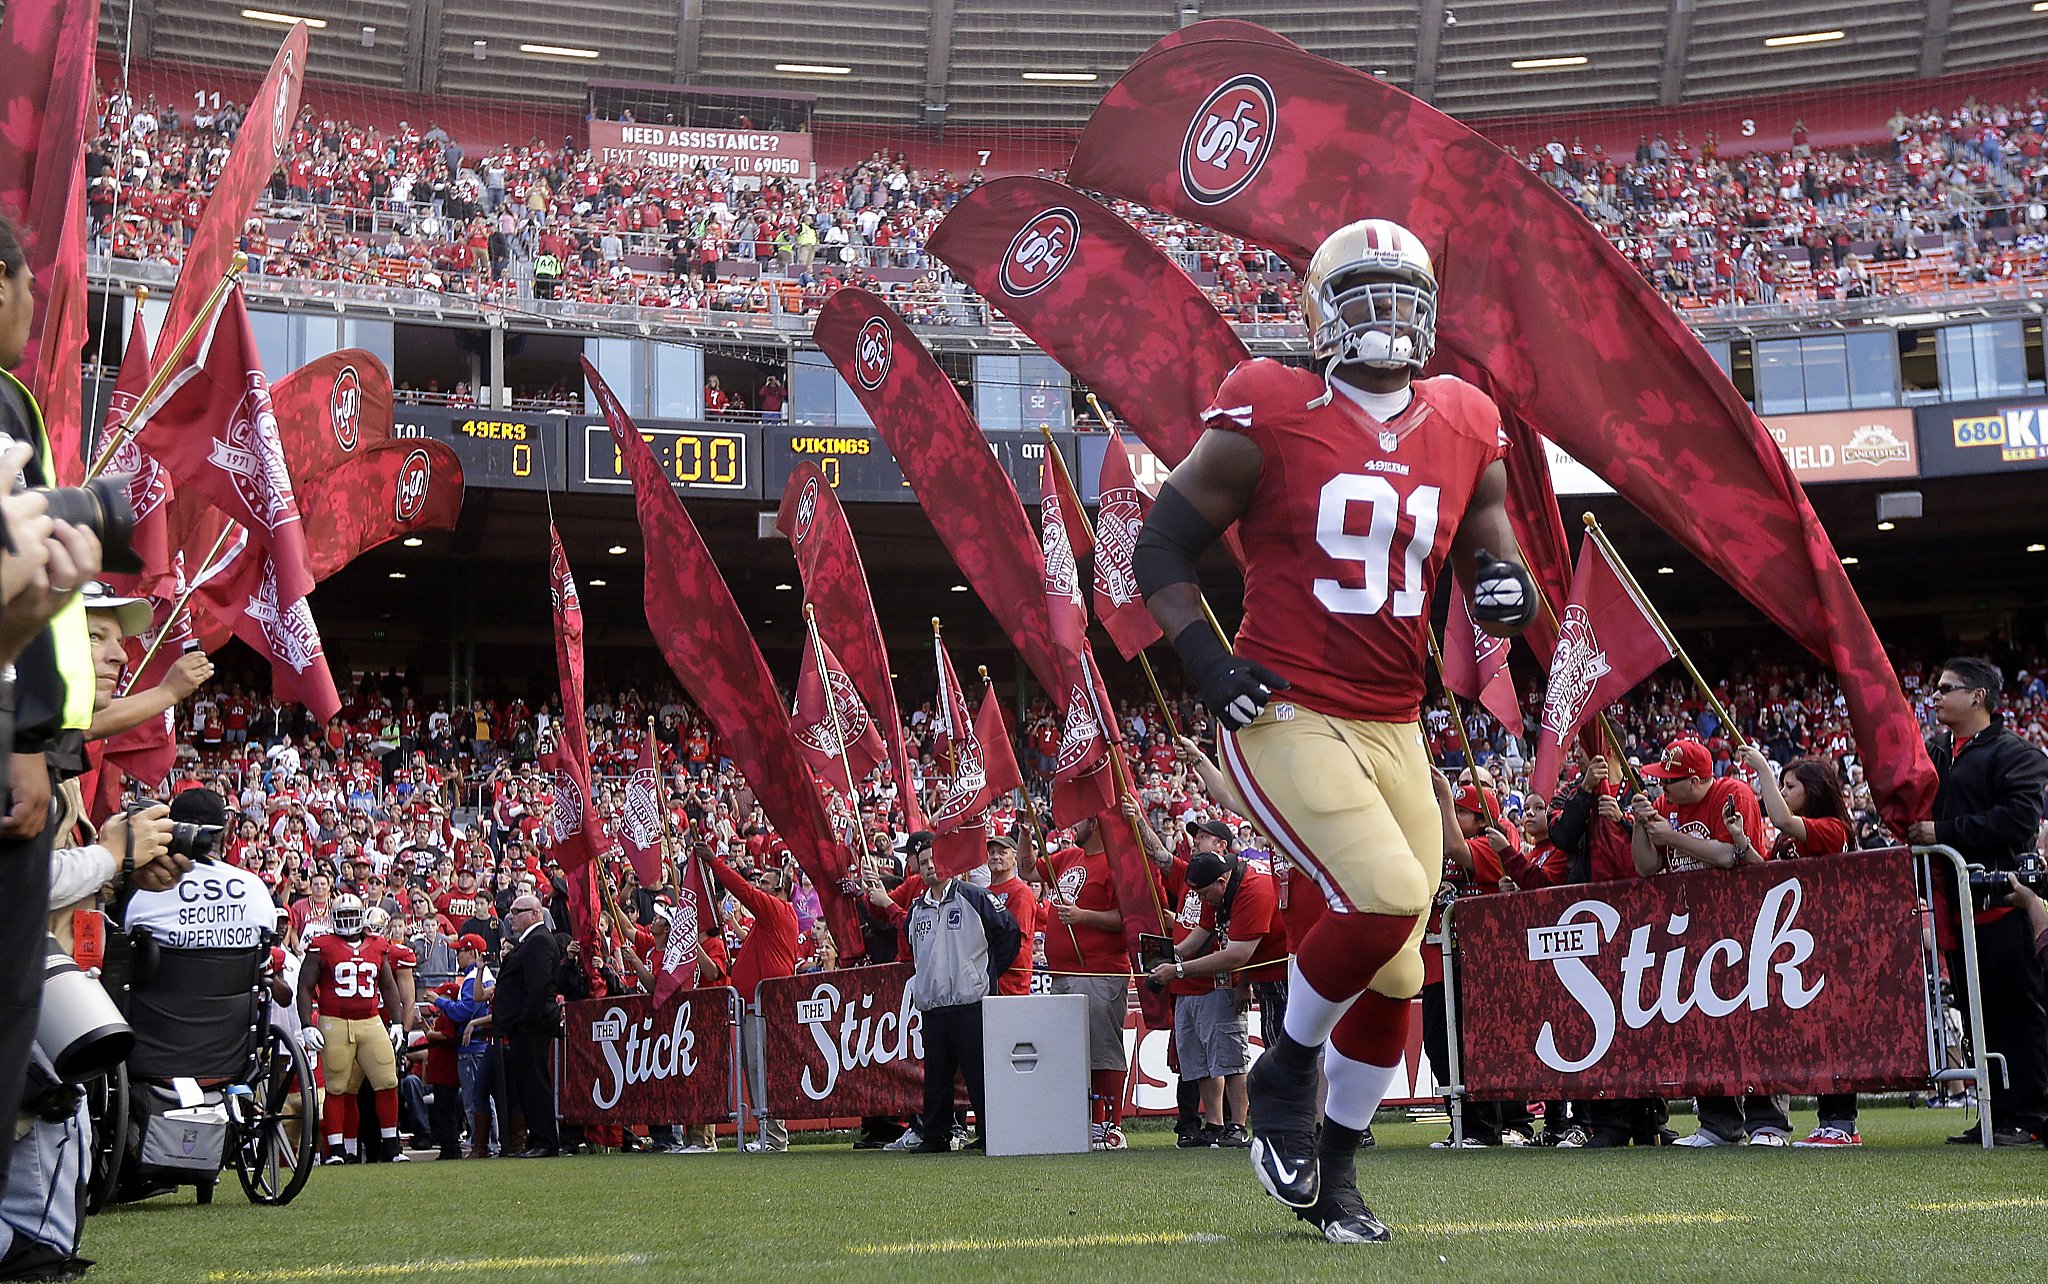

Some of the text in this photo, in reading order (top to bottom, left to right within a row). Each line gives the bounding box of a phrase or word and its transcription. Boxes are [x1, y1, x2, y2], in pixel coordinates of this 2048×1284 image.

[194, 90, 222, 110] 11
[1741, 118, 1756, 136] 3
[622, 126, 780, 152] NEED ASSISTANCE?
[602, 147, 633, 165] TEXT
[733, 156, 750, 172] TO
[753, 157, 800, 174] 69050
[978, 150, 991, 166] 7
[928, 270, 938, 283] 9
[1031, 395, 1046, 409] 52
[462, 420, 527, 441] 49ERS
[1957, 420, 2002, 443] 680
[791, 436, 871, 455] VIKINGS
[226, 452, 250, 469] 1971
[512, 444, 531, 477] 0
[1364, 460, 1411, 477] 49ERS
[821, 457, 840, 488] 0
[1312, 472, 1441, 618] 91
[1111, 576, 1123, 597] 2013
[406, 714, 416, 728] 11
[615, 710, 626, 724] 21
[1044, 730, 1052, 743] 7
[178, 878, 247, 903] CSC
[178, 903, 247, 926] SECURITY
[168, 927, 254, 948] SUPERVISOR
[1538, 929, 1585, 954] THE
[334, 961, 379, 998] 93
[1030, 974, 1053, 995] 28
[1534, 876, 1826, 1073] Stick
[800, 974, 925, 1101] THE Stick
[592, 1000, 698, 1110] THE Stick
